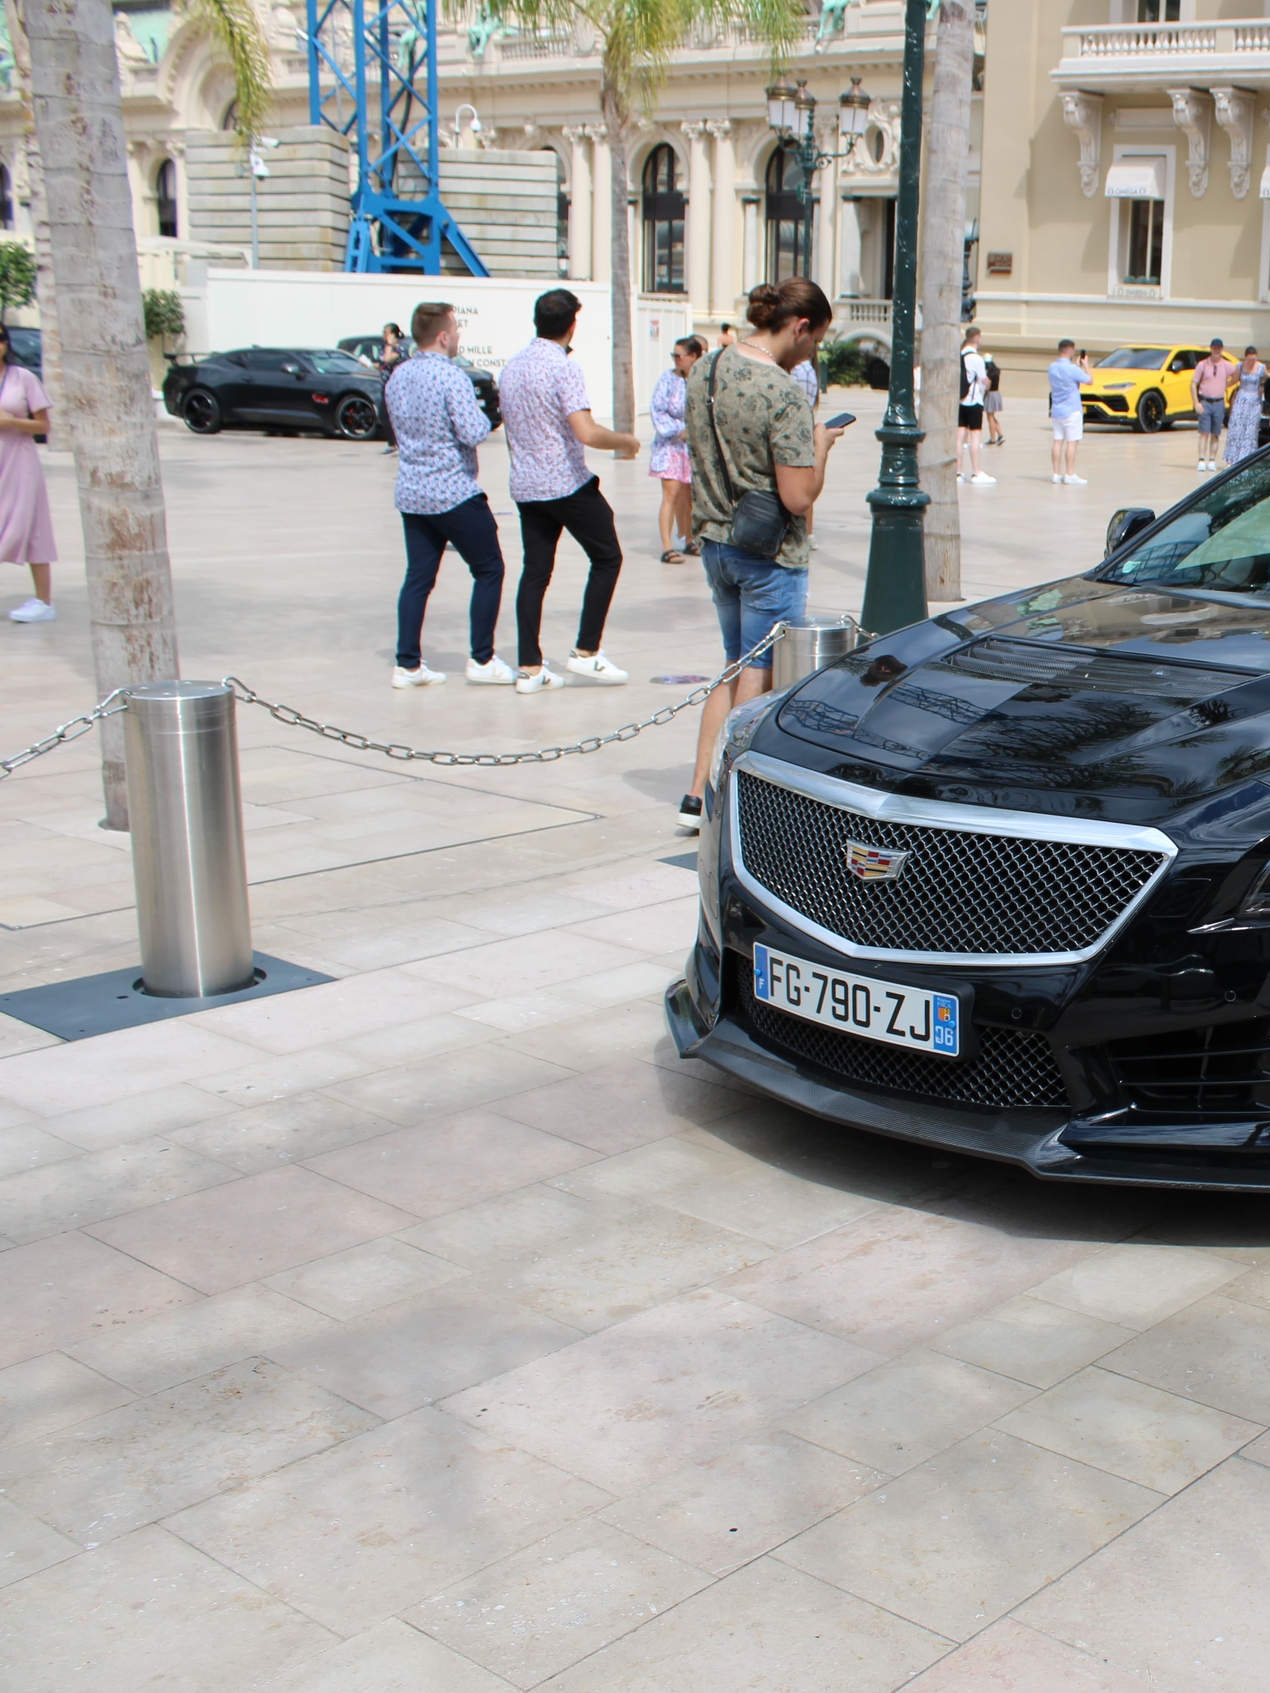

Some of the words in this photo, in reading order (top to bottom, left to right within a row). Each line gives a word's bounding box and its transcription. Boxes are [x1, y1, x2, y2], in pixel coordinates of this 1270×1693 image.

[466, 345, 493, 355] MILLE
[759, 978, 765, 989] F
[769, 956, 931, 1042] FG-790-ZJ
